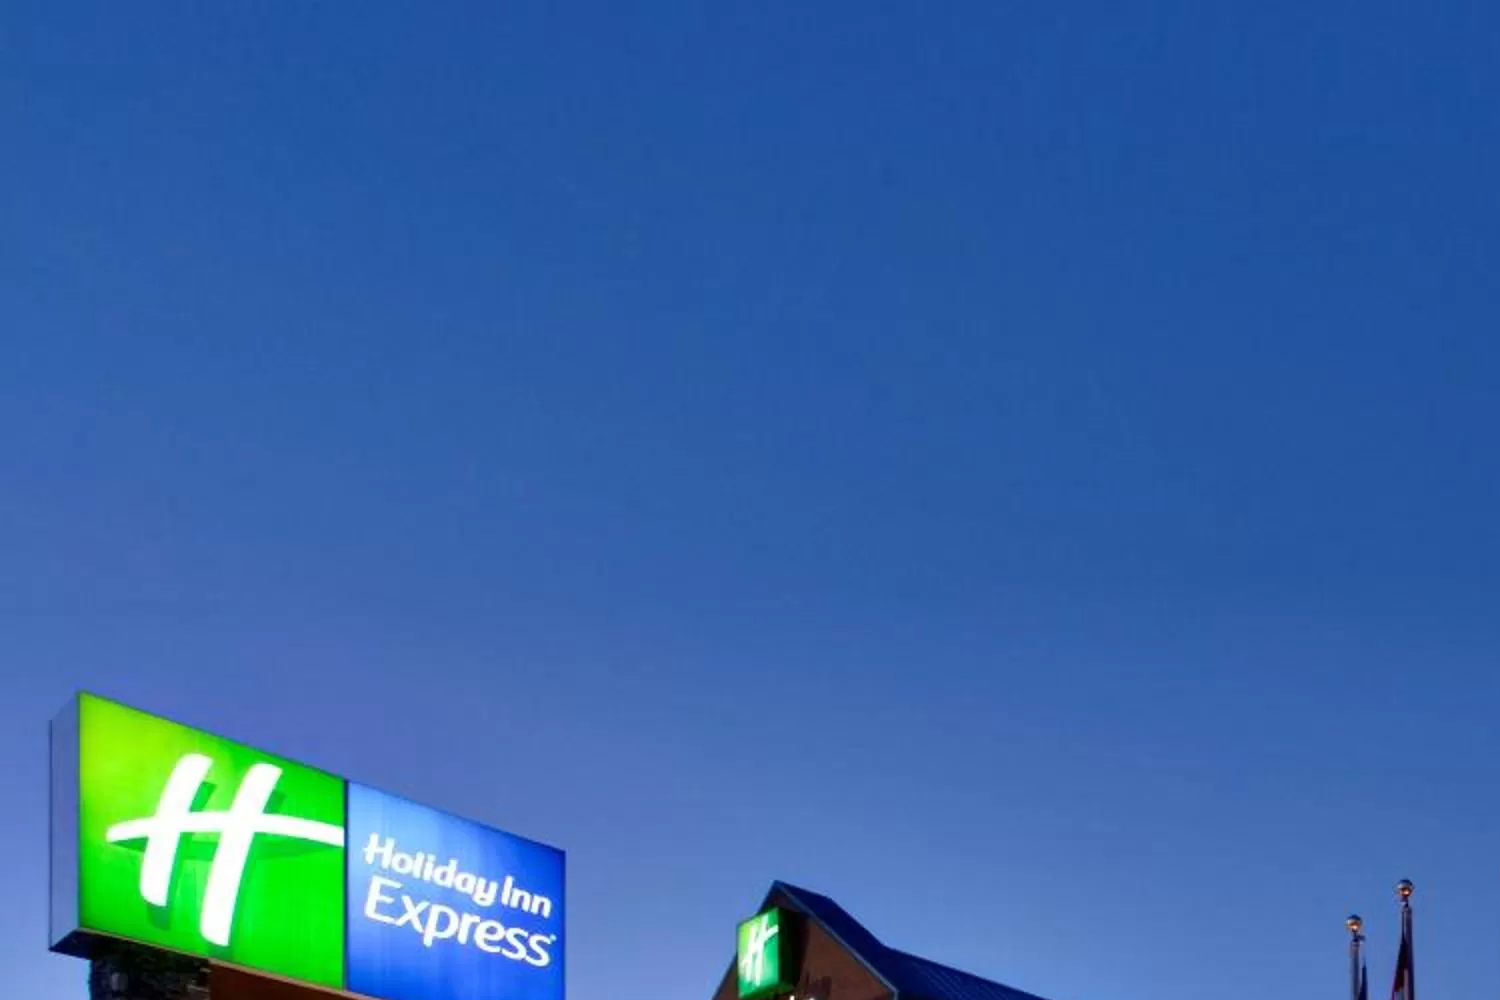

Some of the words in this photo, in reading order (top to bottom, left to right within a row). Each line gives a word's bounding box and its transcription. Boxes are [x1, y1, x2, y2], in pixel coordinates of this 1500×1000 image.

[363, 832, 498, 907] Holiday
[501, 875, 552, 918] Inn
[364, 874, 552, 967] Express
